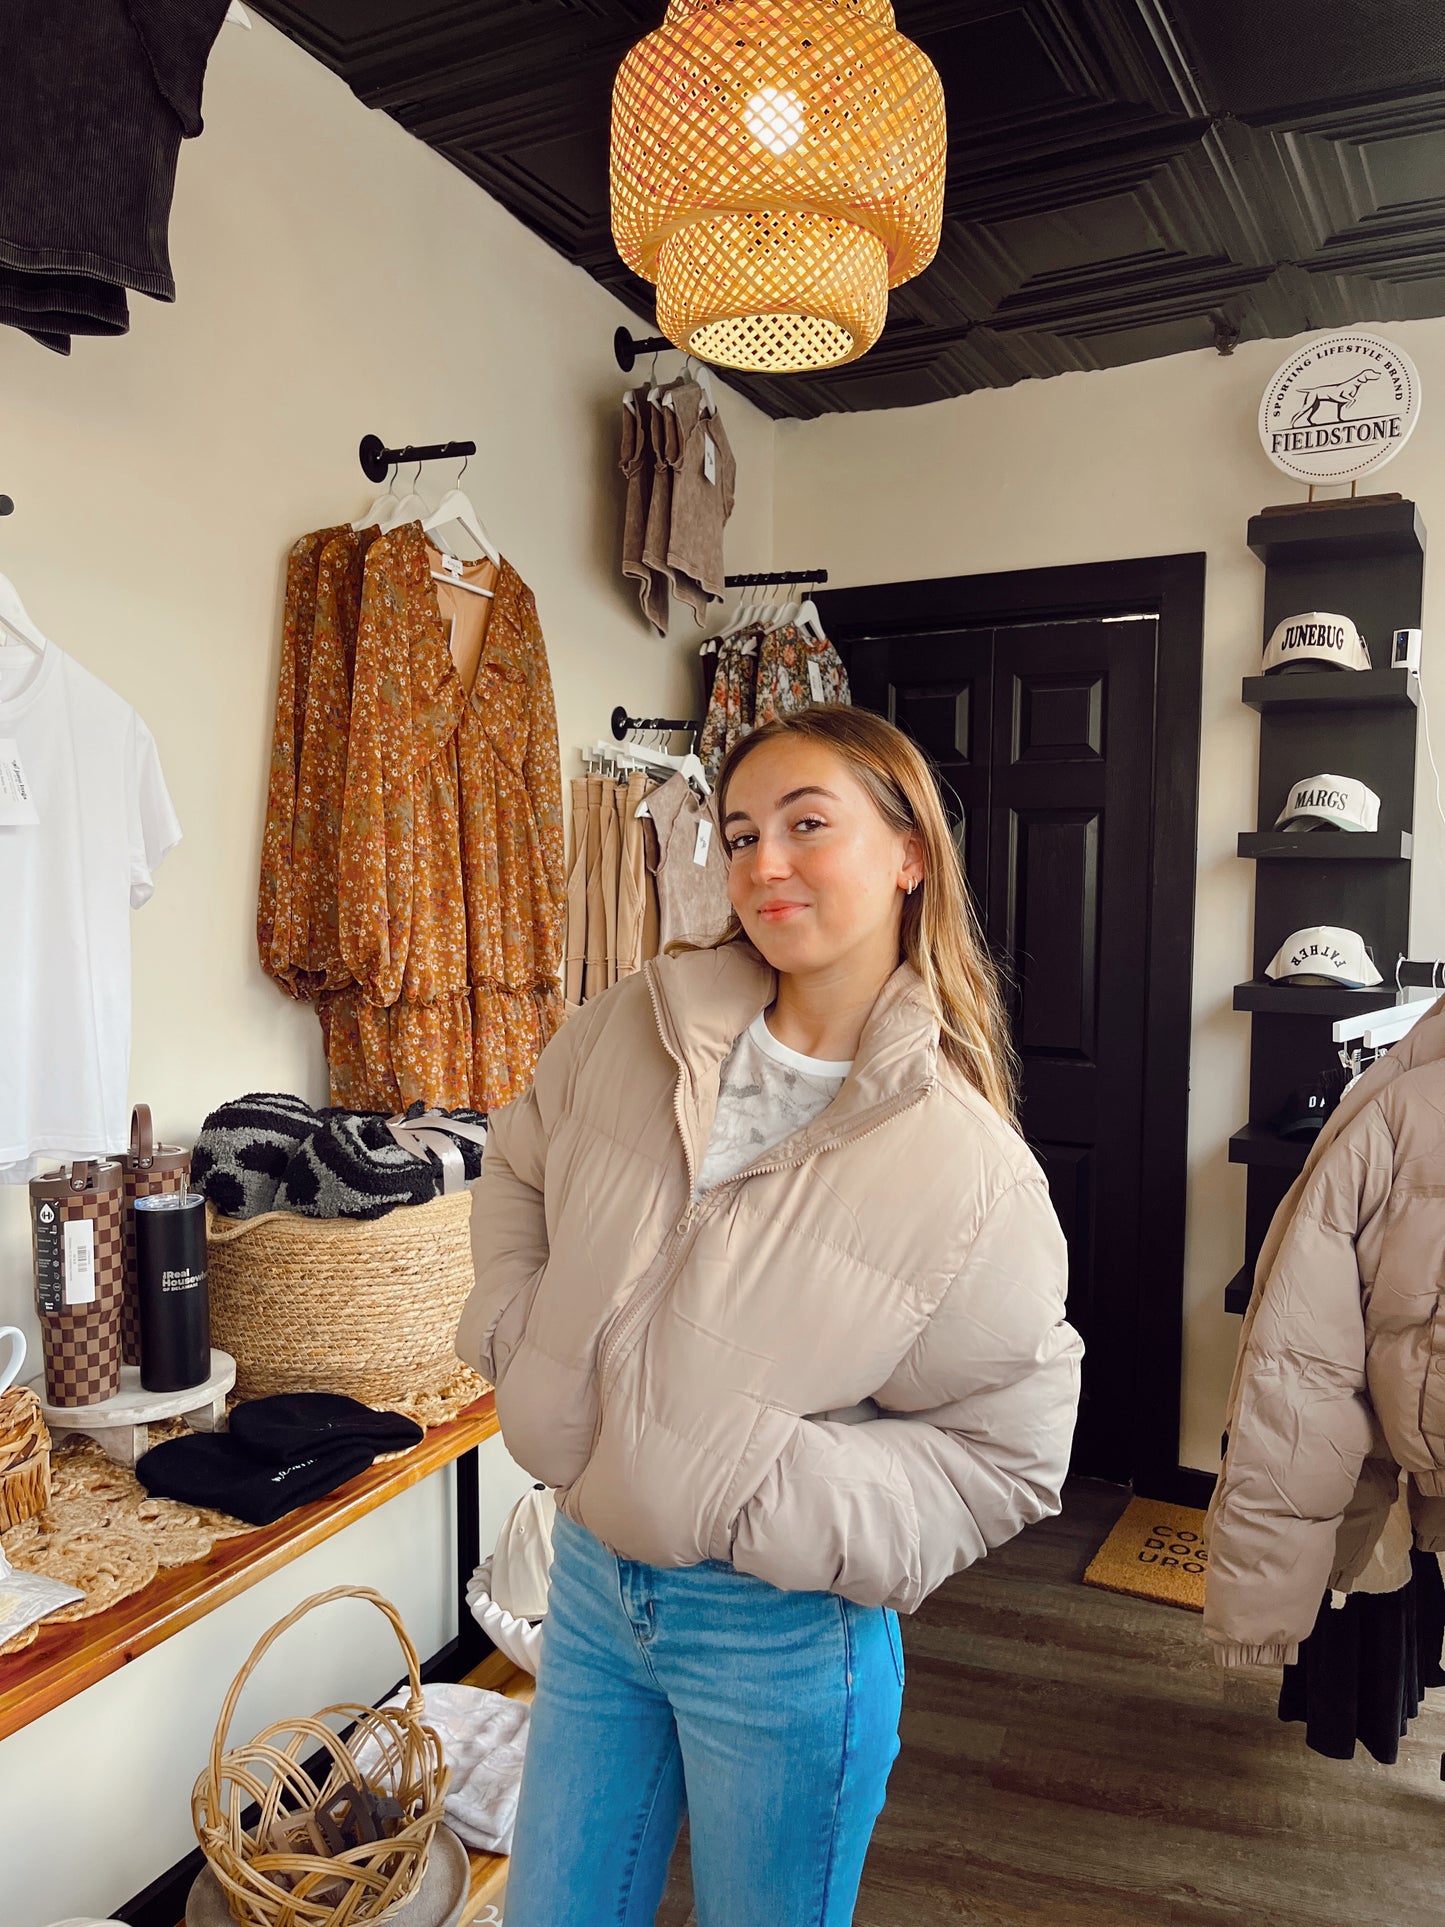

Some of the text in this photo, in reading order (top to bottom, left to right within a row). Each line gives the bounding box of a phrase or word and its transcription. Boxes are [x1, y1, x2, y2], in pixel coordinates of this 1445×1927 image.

[1273, 344, 1403, 417] SPORTING LIFESTYLE BRAND
[1271, 417, 1402, 454] FIELDSTONE
[1281, 624, 1344, 651] JUNEBUG
[1294, 789, 1348, 811] MARGS
[1291, 944, 1347, 968] FATHER
[1152, 1525, 1204, 1545] CO
